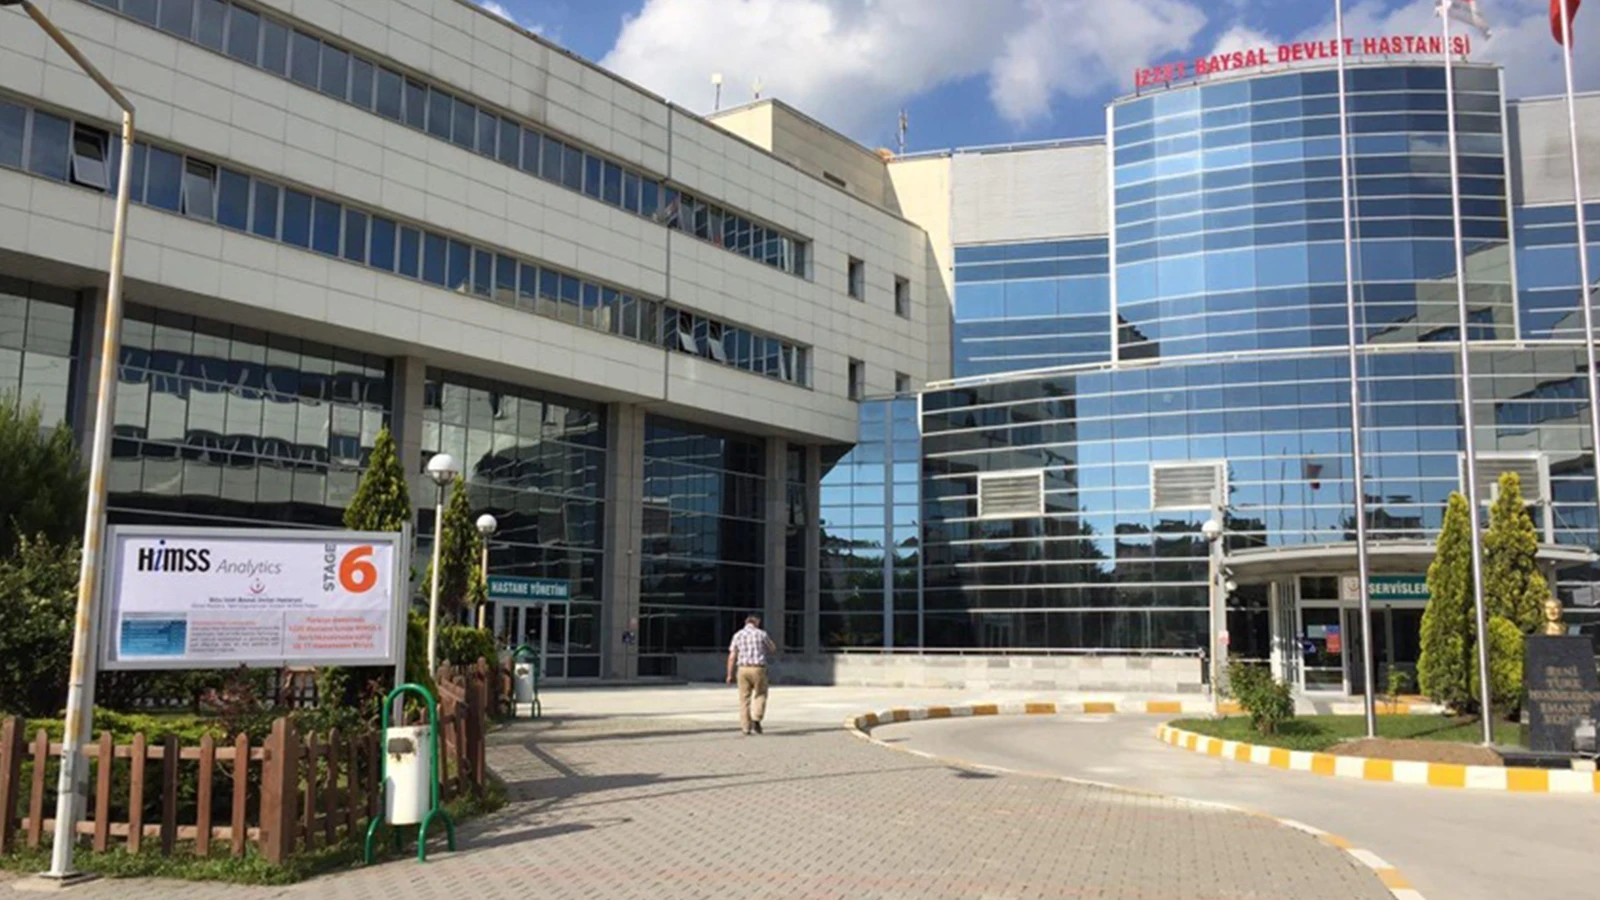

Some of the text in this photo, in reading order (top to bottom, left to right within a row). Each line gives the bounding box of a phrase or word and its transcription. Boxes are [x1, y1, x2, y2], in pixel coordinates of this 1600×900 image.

[1194, 49, 1268, 76] BAYSAL
[1278, 38, 1354, 62] DEVLET
[215, 559, 282, 577] Analytics
[323, 543, 337, 592] STAGE
[339, 545, 378, 593] 6
[491, 581, 528, 595] HASTANE
[1368, 581, 1430, 594] SERVİSLER
